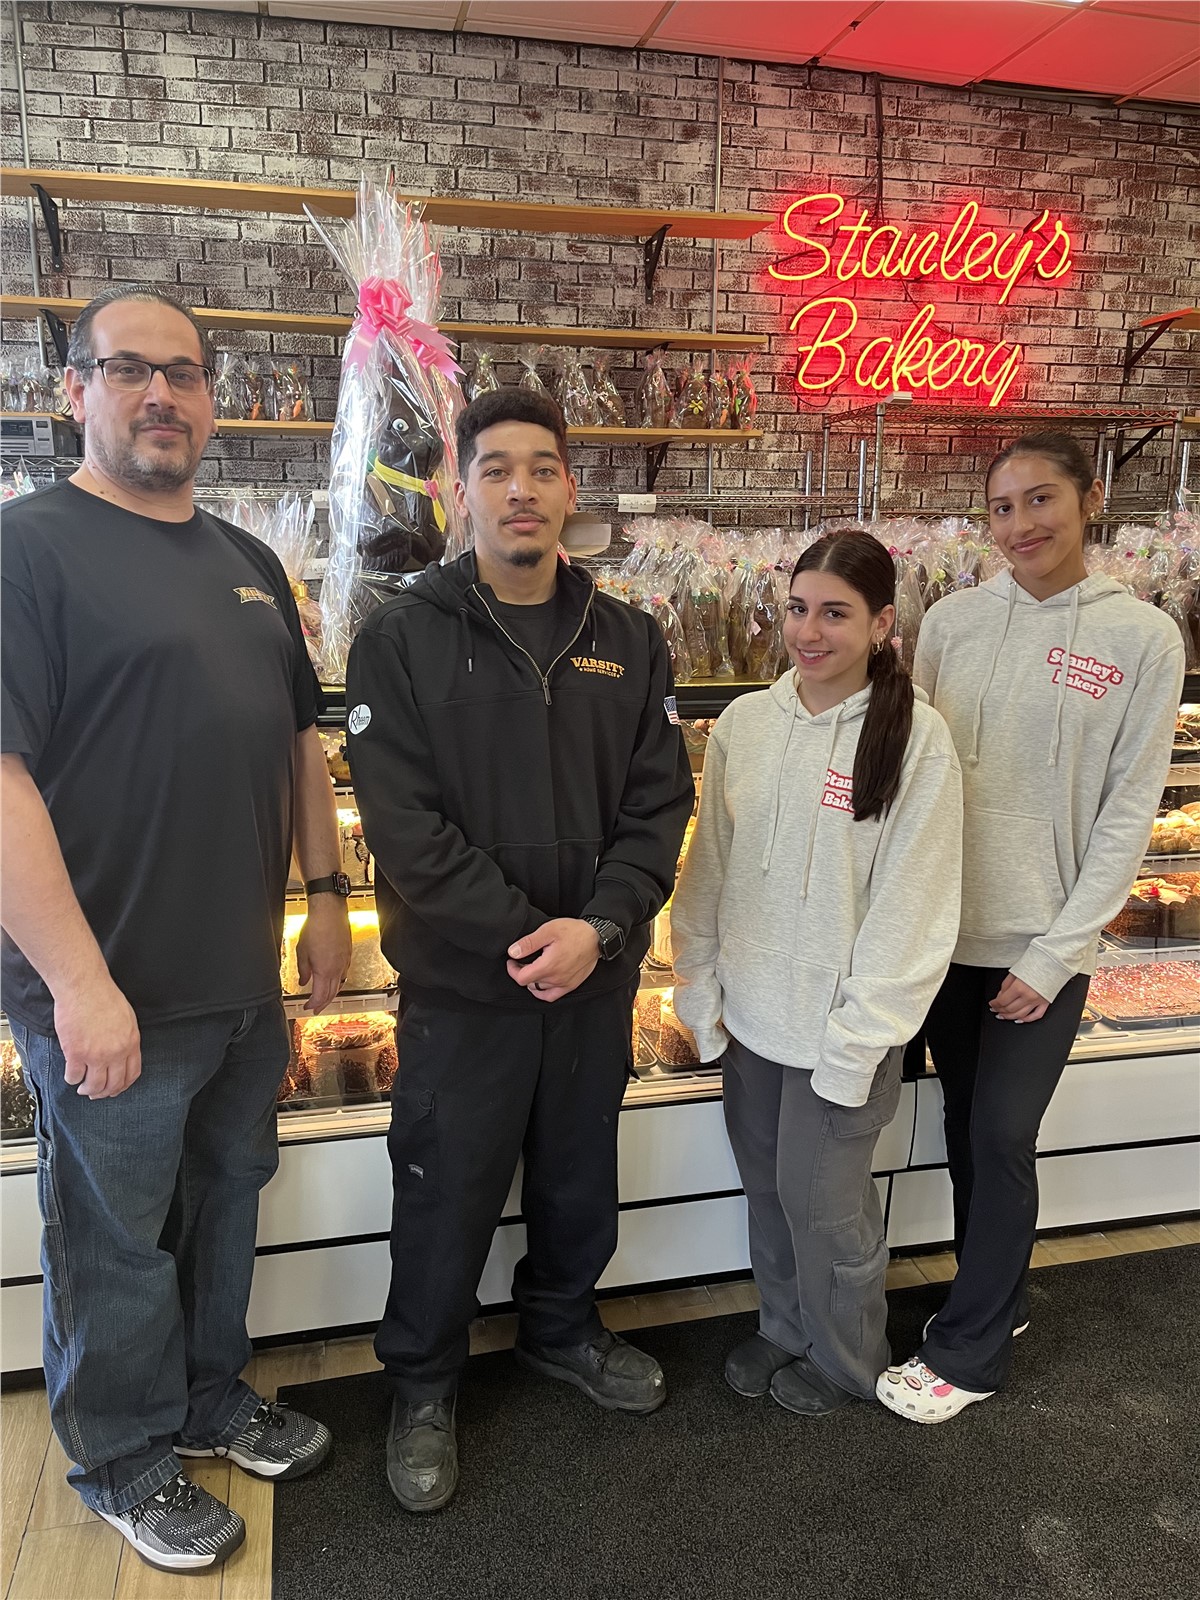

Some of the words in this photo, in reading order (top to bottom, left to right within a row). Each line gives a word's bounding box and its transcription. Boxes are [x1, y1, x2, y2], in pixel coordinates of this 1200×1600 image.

[769, 193, 1072, 304] Stanley's
[789, 297, 1023, 407] Bakery
[570, 656, 625, 676] VARSITY
